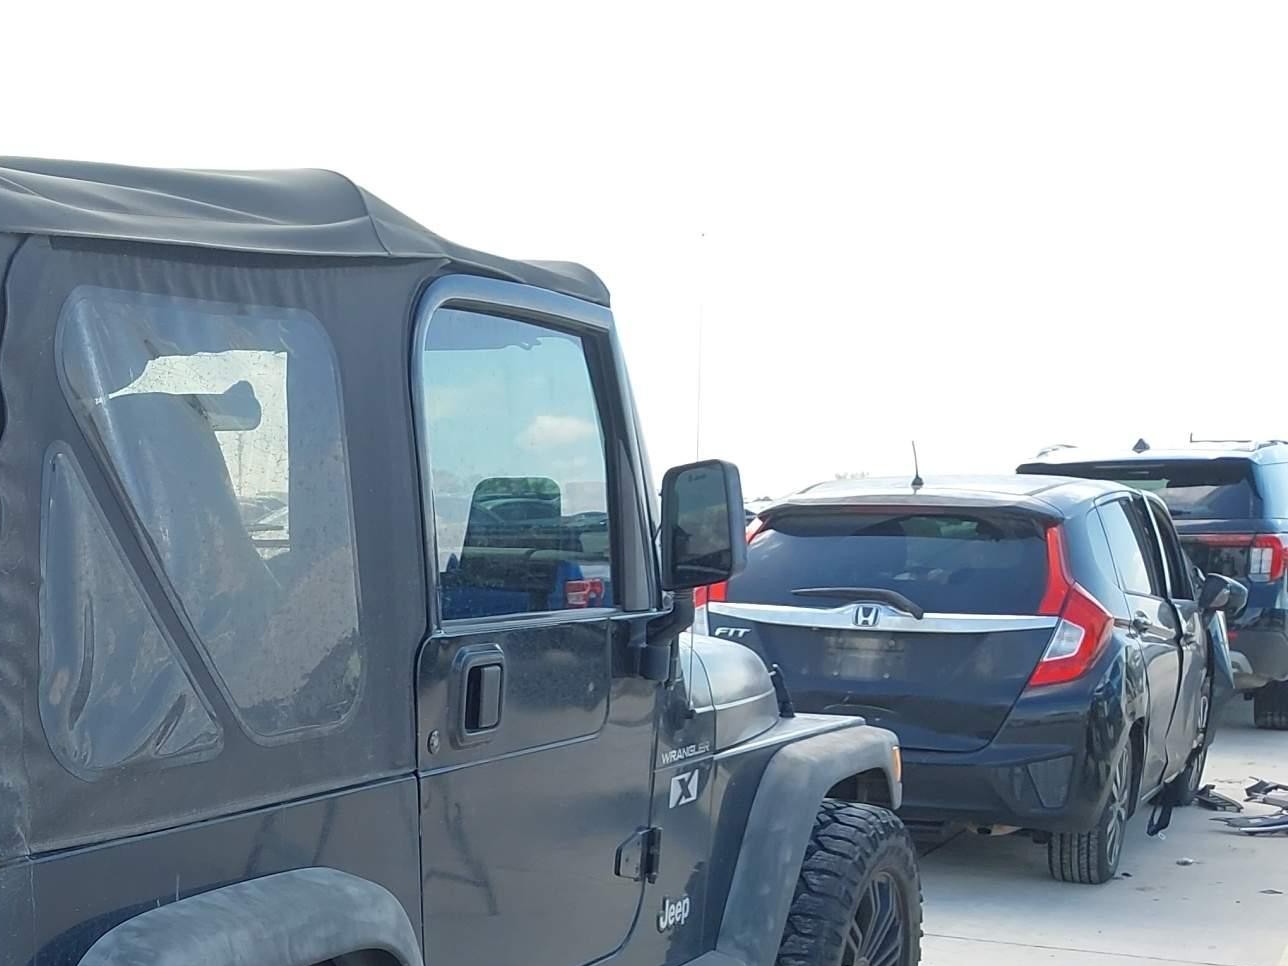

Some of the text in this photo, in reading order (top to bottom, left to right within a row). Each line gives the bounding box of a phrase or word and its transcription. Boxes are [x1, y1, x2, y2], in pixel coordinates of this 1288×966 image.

[714, 627, 752, 638] FIT
[661, 741, 710, 765] WRANGLER
[659, 897, 690, 929] Jeep
